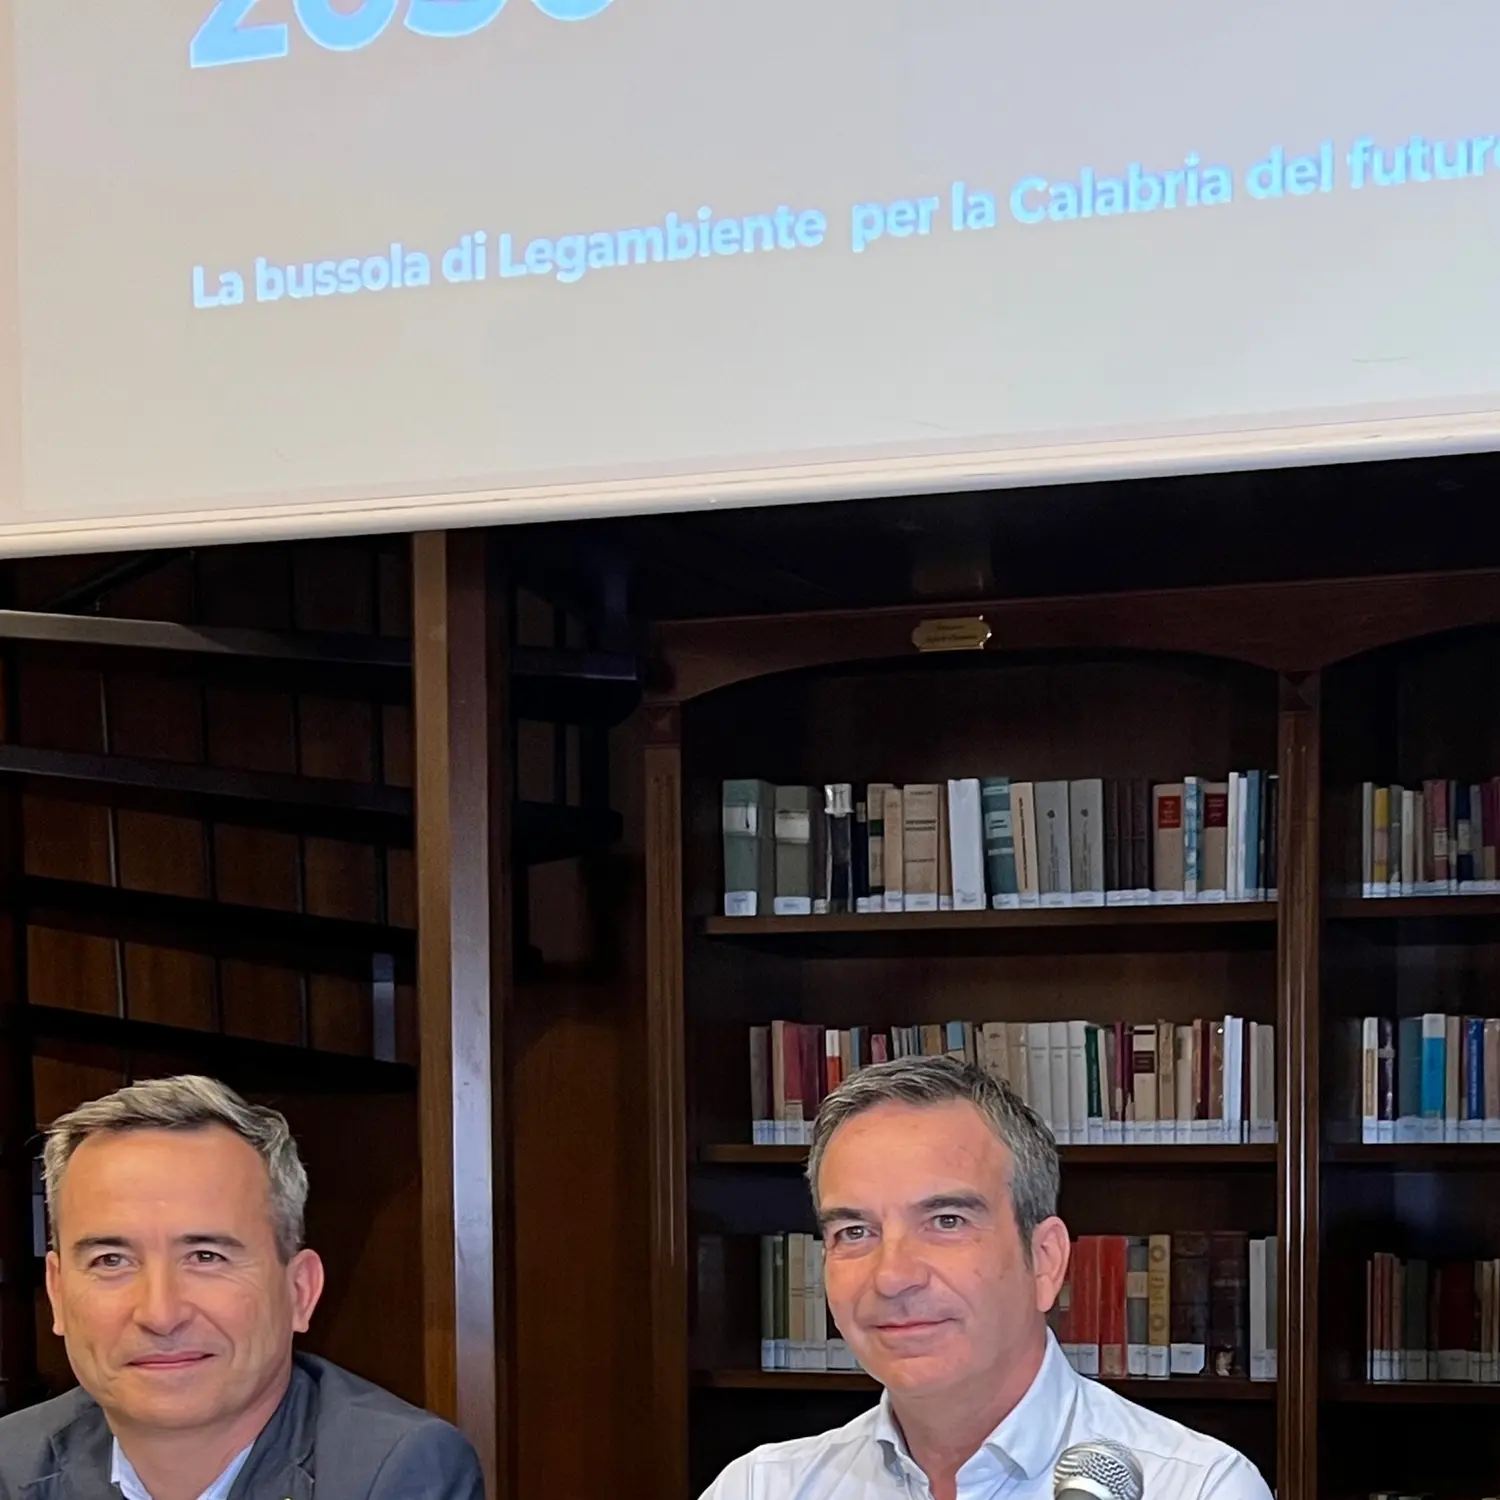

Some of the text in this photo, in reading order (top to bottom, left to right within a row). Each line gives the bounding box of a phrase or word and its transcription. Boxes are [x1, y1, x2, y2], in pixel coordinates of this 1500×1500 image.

[194, 265, 244, 309] La
[255, 242, 431, 302] bussola
[442, 230, 487, 284] di
[498, 205, 828, 284] Legambiente
[850, 196, 940, 253] per
[951, 181, 997, 231] la
[1009, 151, 1233, 226] Calabria
[1245, 140, 1335, 201] del
